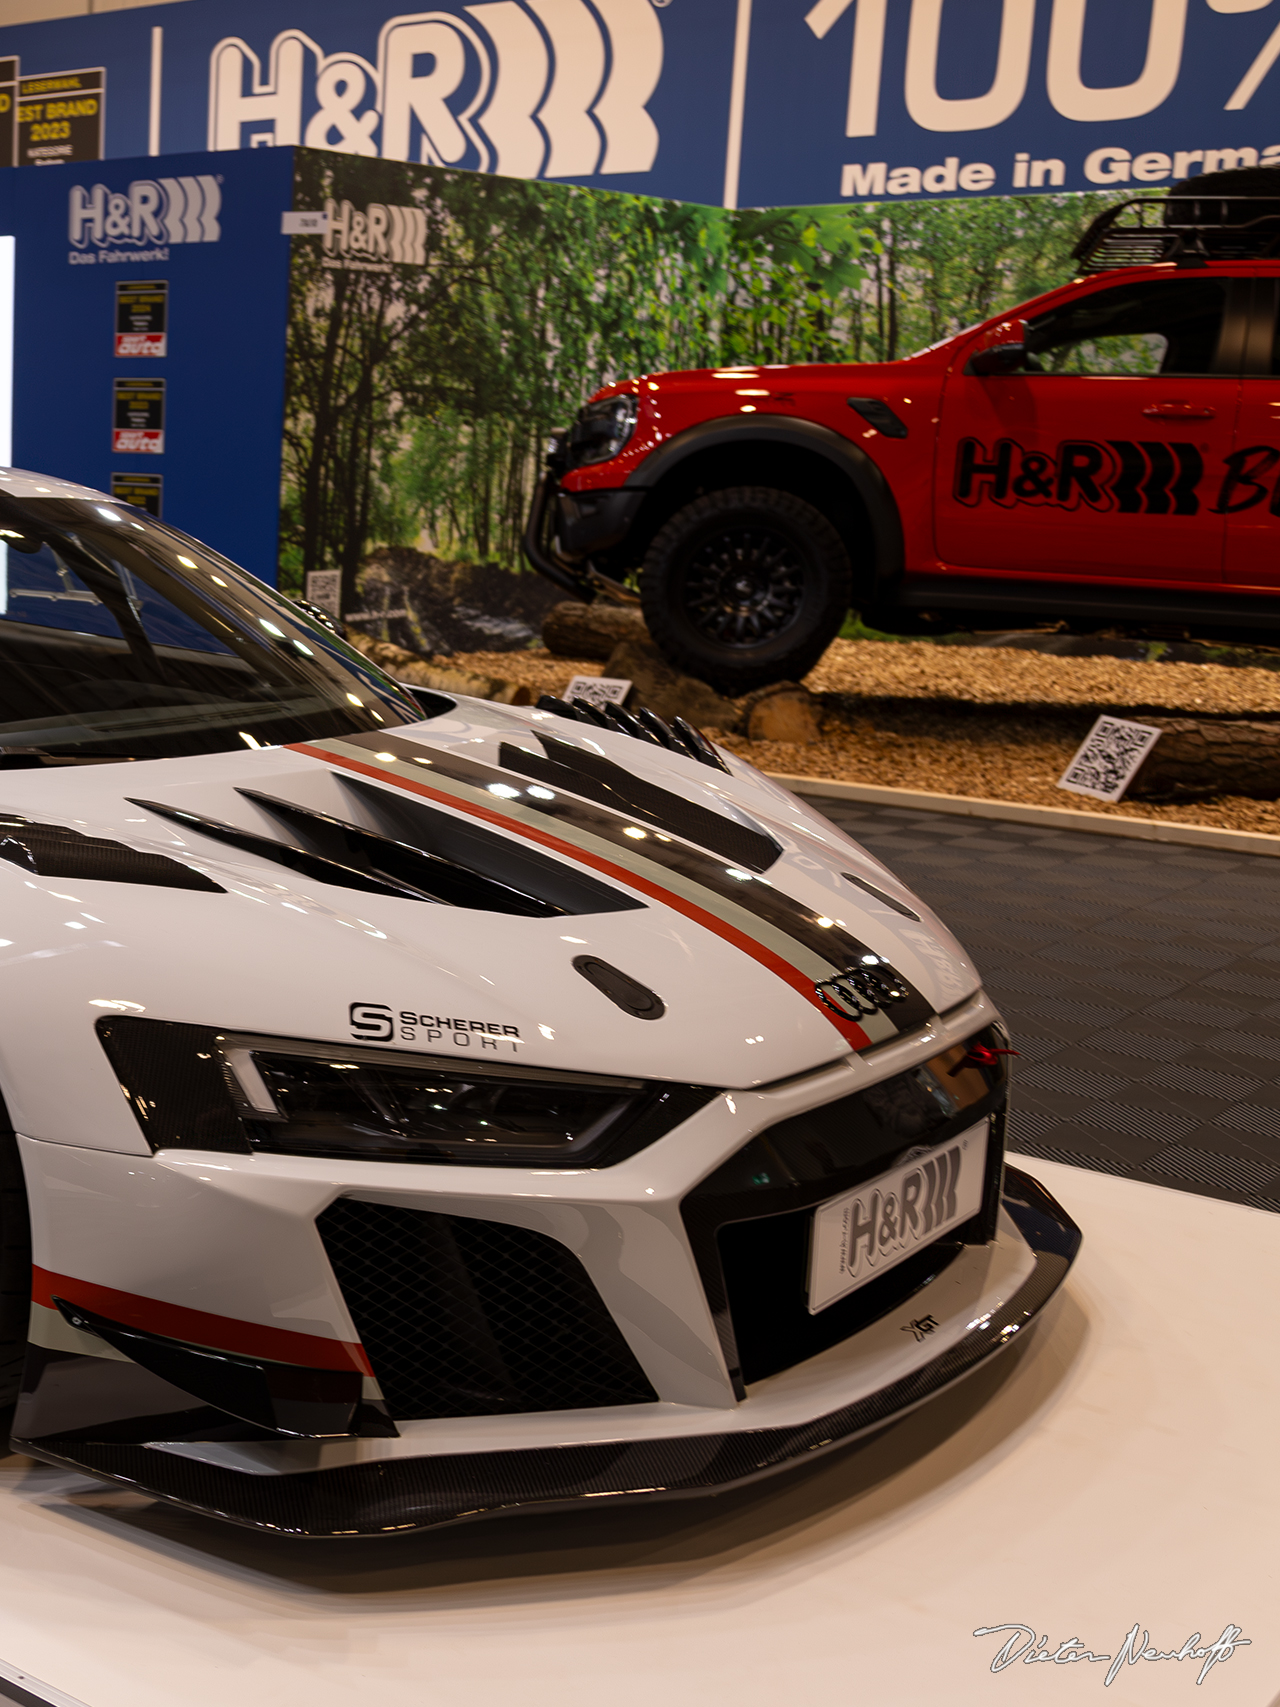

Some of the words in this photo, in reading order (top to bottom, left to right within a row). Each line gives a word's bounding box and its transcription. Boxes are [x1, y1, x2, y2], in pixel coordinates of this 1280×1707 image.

[804, 0, 1280, 137] 100
[17, 104, 43, 122] EST
[45, 98, 98, 119] BRAND
[29, 121, 70, 142] 2023
[840, 156, 996, 197] Made
[1012, 151, 1066, 189] in
[69, 180, 170, 249] H&R
[323, 198, 394, 263] H&R
[953, 437, 1115, 513] H&R
[1206, 445, 1280, 517] B
[399, 1011, 521, 1038] SCHERER
[847, 1167, 927, 1278] H&R
